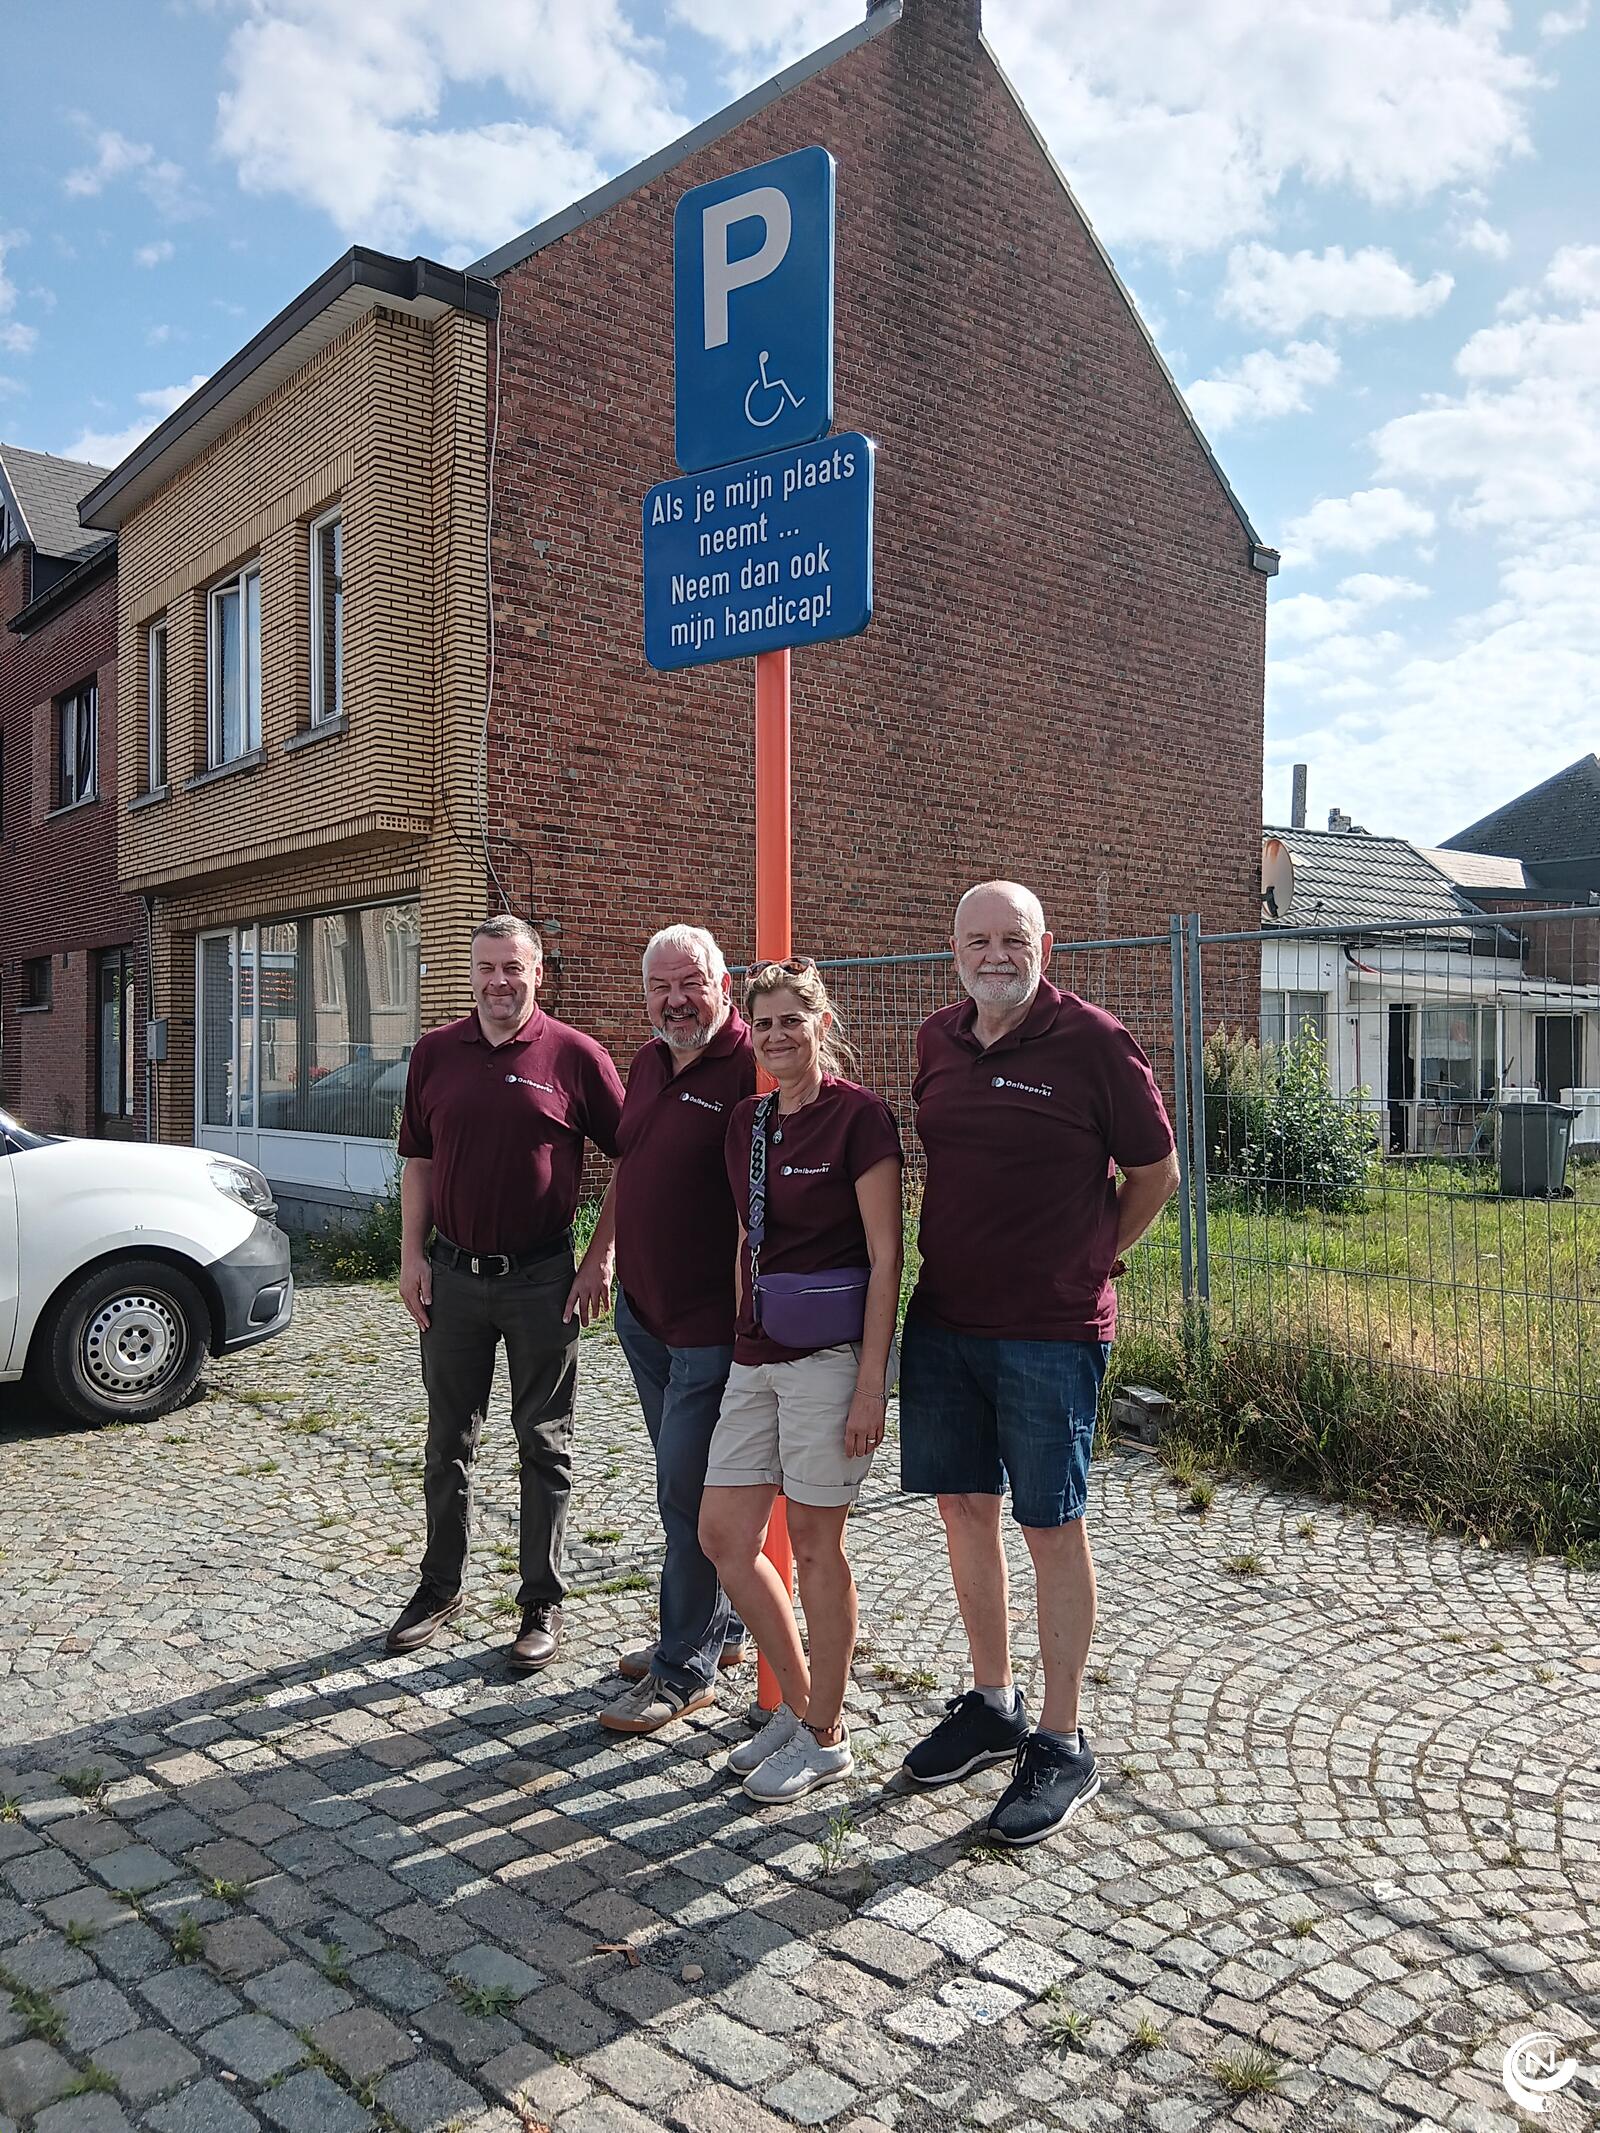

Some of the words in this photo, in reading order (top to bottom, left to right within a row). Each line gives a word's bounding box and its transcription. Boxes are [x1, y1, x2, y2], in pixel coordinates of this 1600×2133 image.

[703, 187, 792, 350] P
[651, 493, 683, 526] Als
[693, 485, 715, 523] je
[725, 470, 772, 509] mijn
[783, 449, 855, 501] plaats
[699, 512, 768, 557] neemt
[671, 571, 730, 605] Neem
[740, 558, 779, 590] dan
[790, 542, 831, 579] ook
[671, 612, 715, 650] mijn
[725, 585, 832, 637] handicap!
